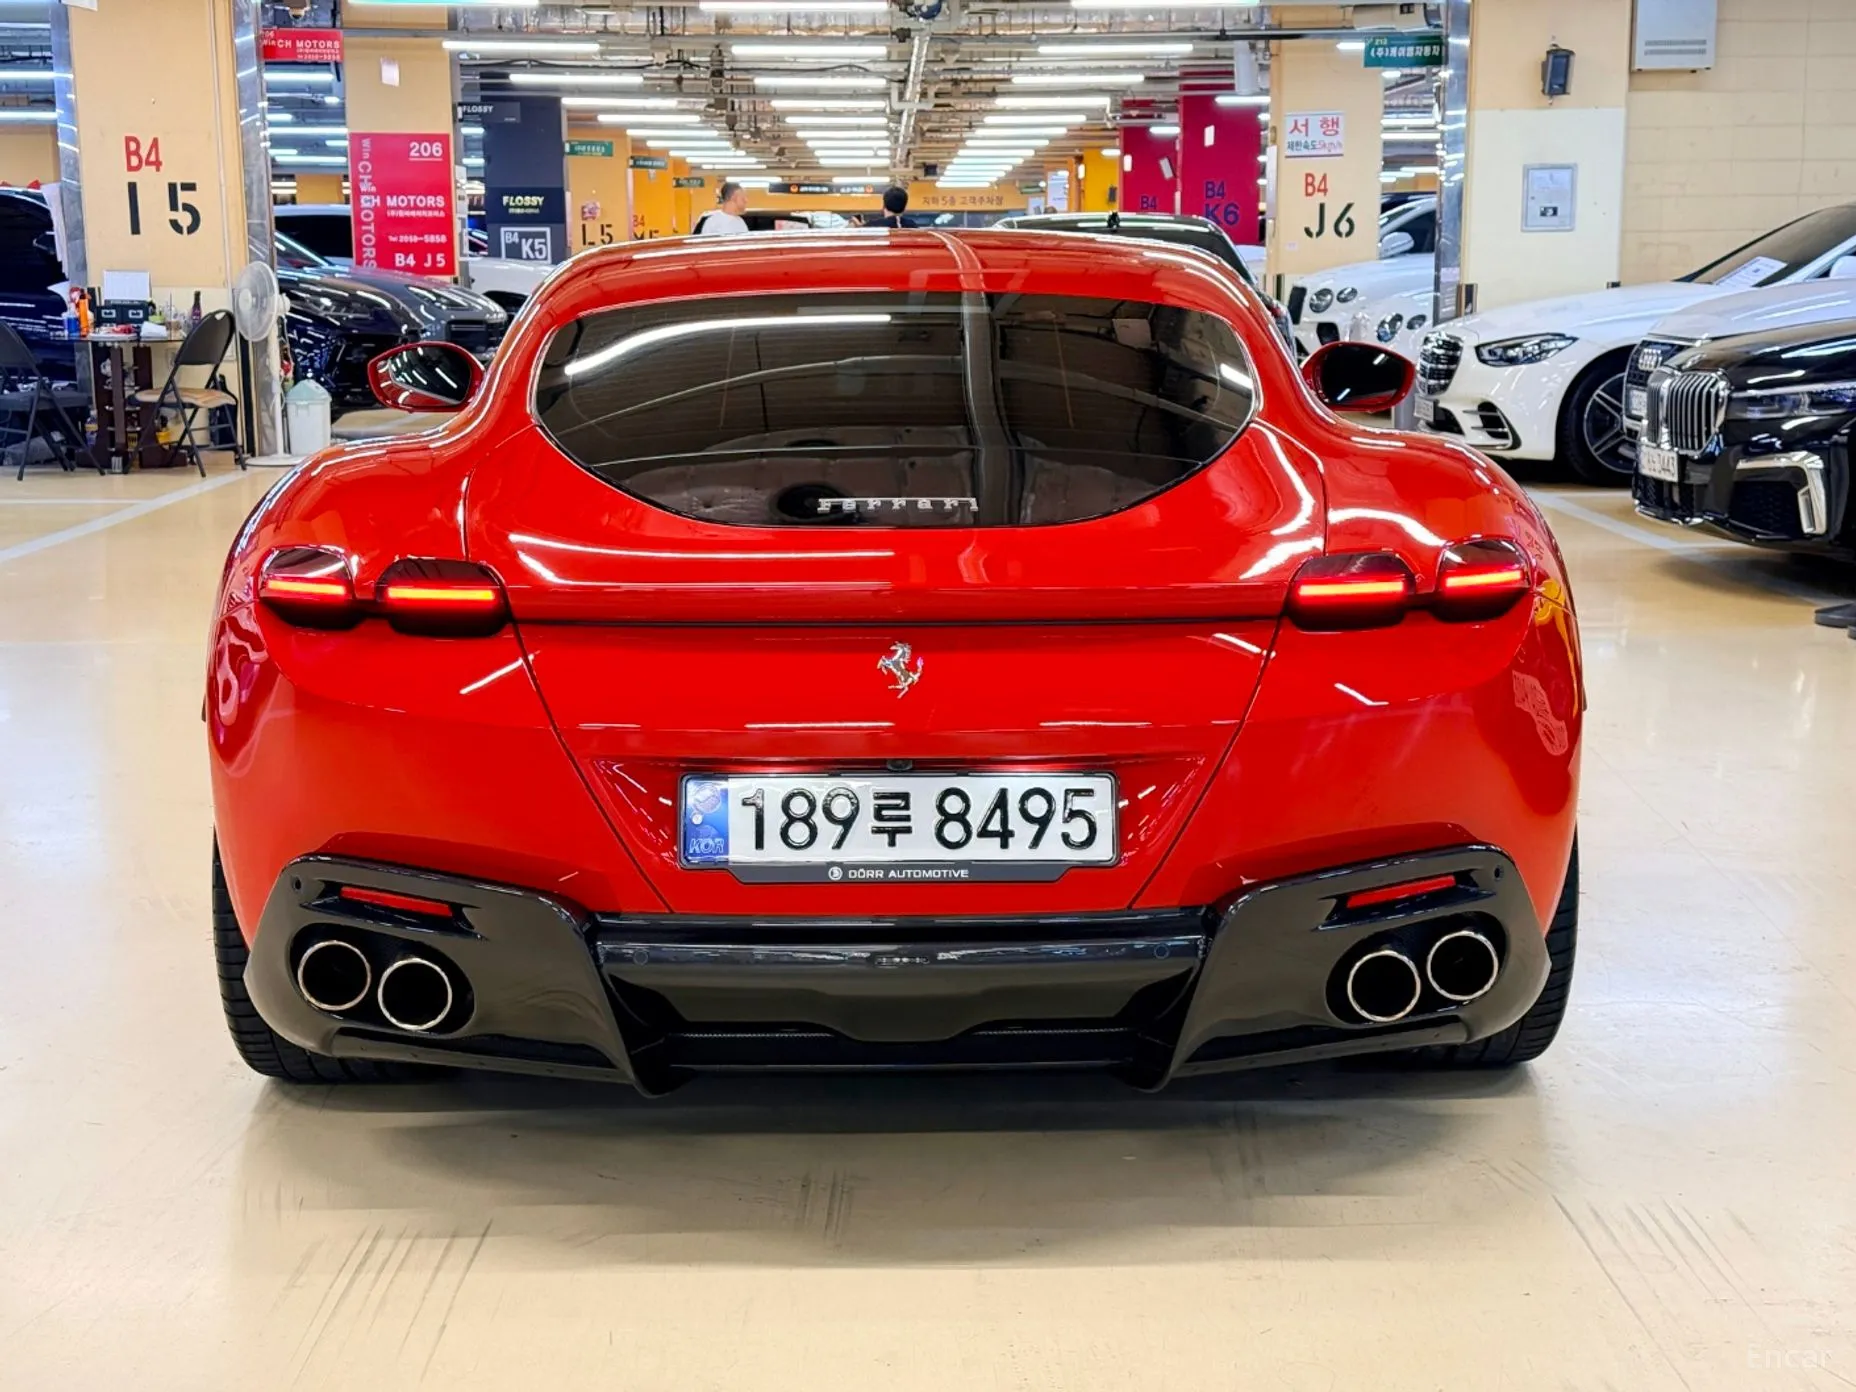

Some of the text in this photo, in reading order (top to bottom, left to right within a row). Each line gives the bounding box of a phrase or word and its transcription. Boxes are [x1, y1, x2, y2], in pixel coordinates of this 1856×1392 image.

[296, 40, 340, 48] MOTORS
[463, 105, 494, 113] FLOSSY
[124, 135, 163, 172] B4
[409, 142, 443, 157] 206
[1205, 181, 1225, 199] B4
[1305, 172, 1329, 197] B4
[387, 195, 446, 208] MOTORS
[503, 195, 545, 207] FLOSSY
[1140, 196, 1157, 210] B4
[1205, 203, 1241, 226] K6
[505, 231, 519, 244] B4
[521, 238, 547, 260] K5
[395, 253, 416, 268] B4
[817, 498, 979, 514] Ferrari
[935, 786, 1098, 851] 8495
[689, 838, 725, 854] KOR
[848, 867, 969, 879] DÖRR AUTOMOTIVE
